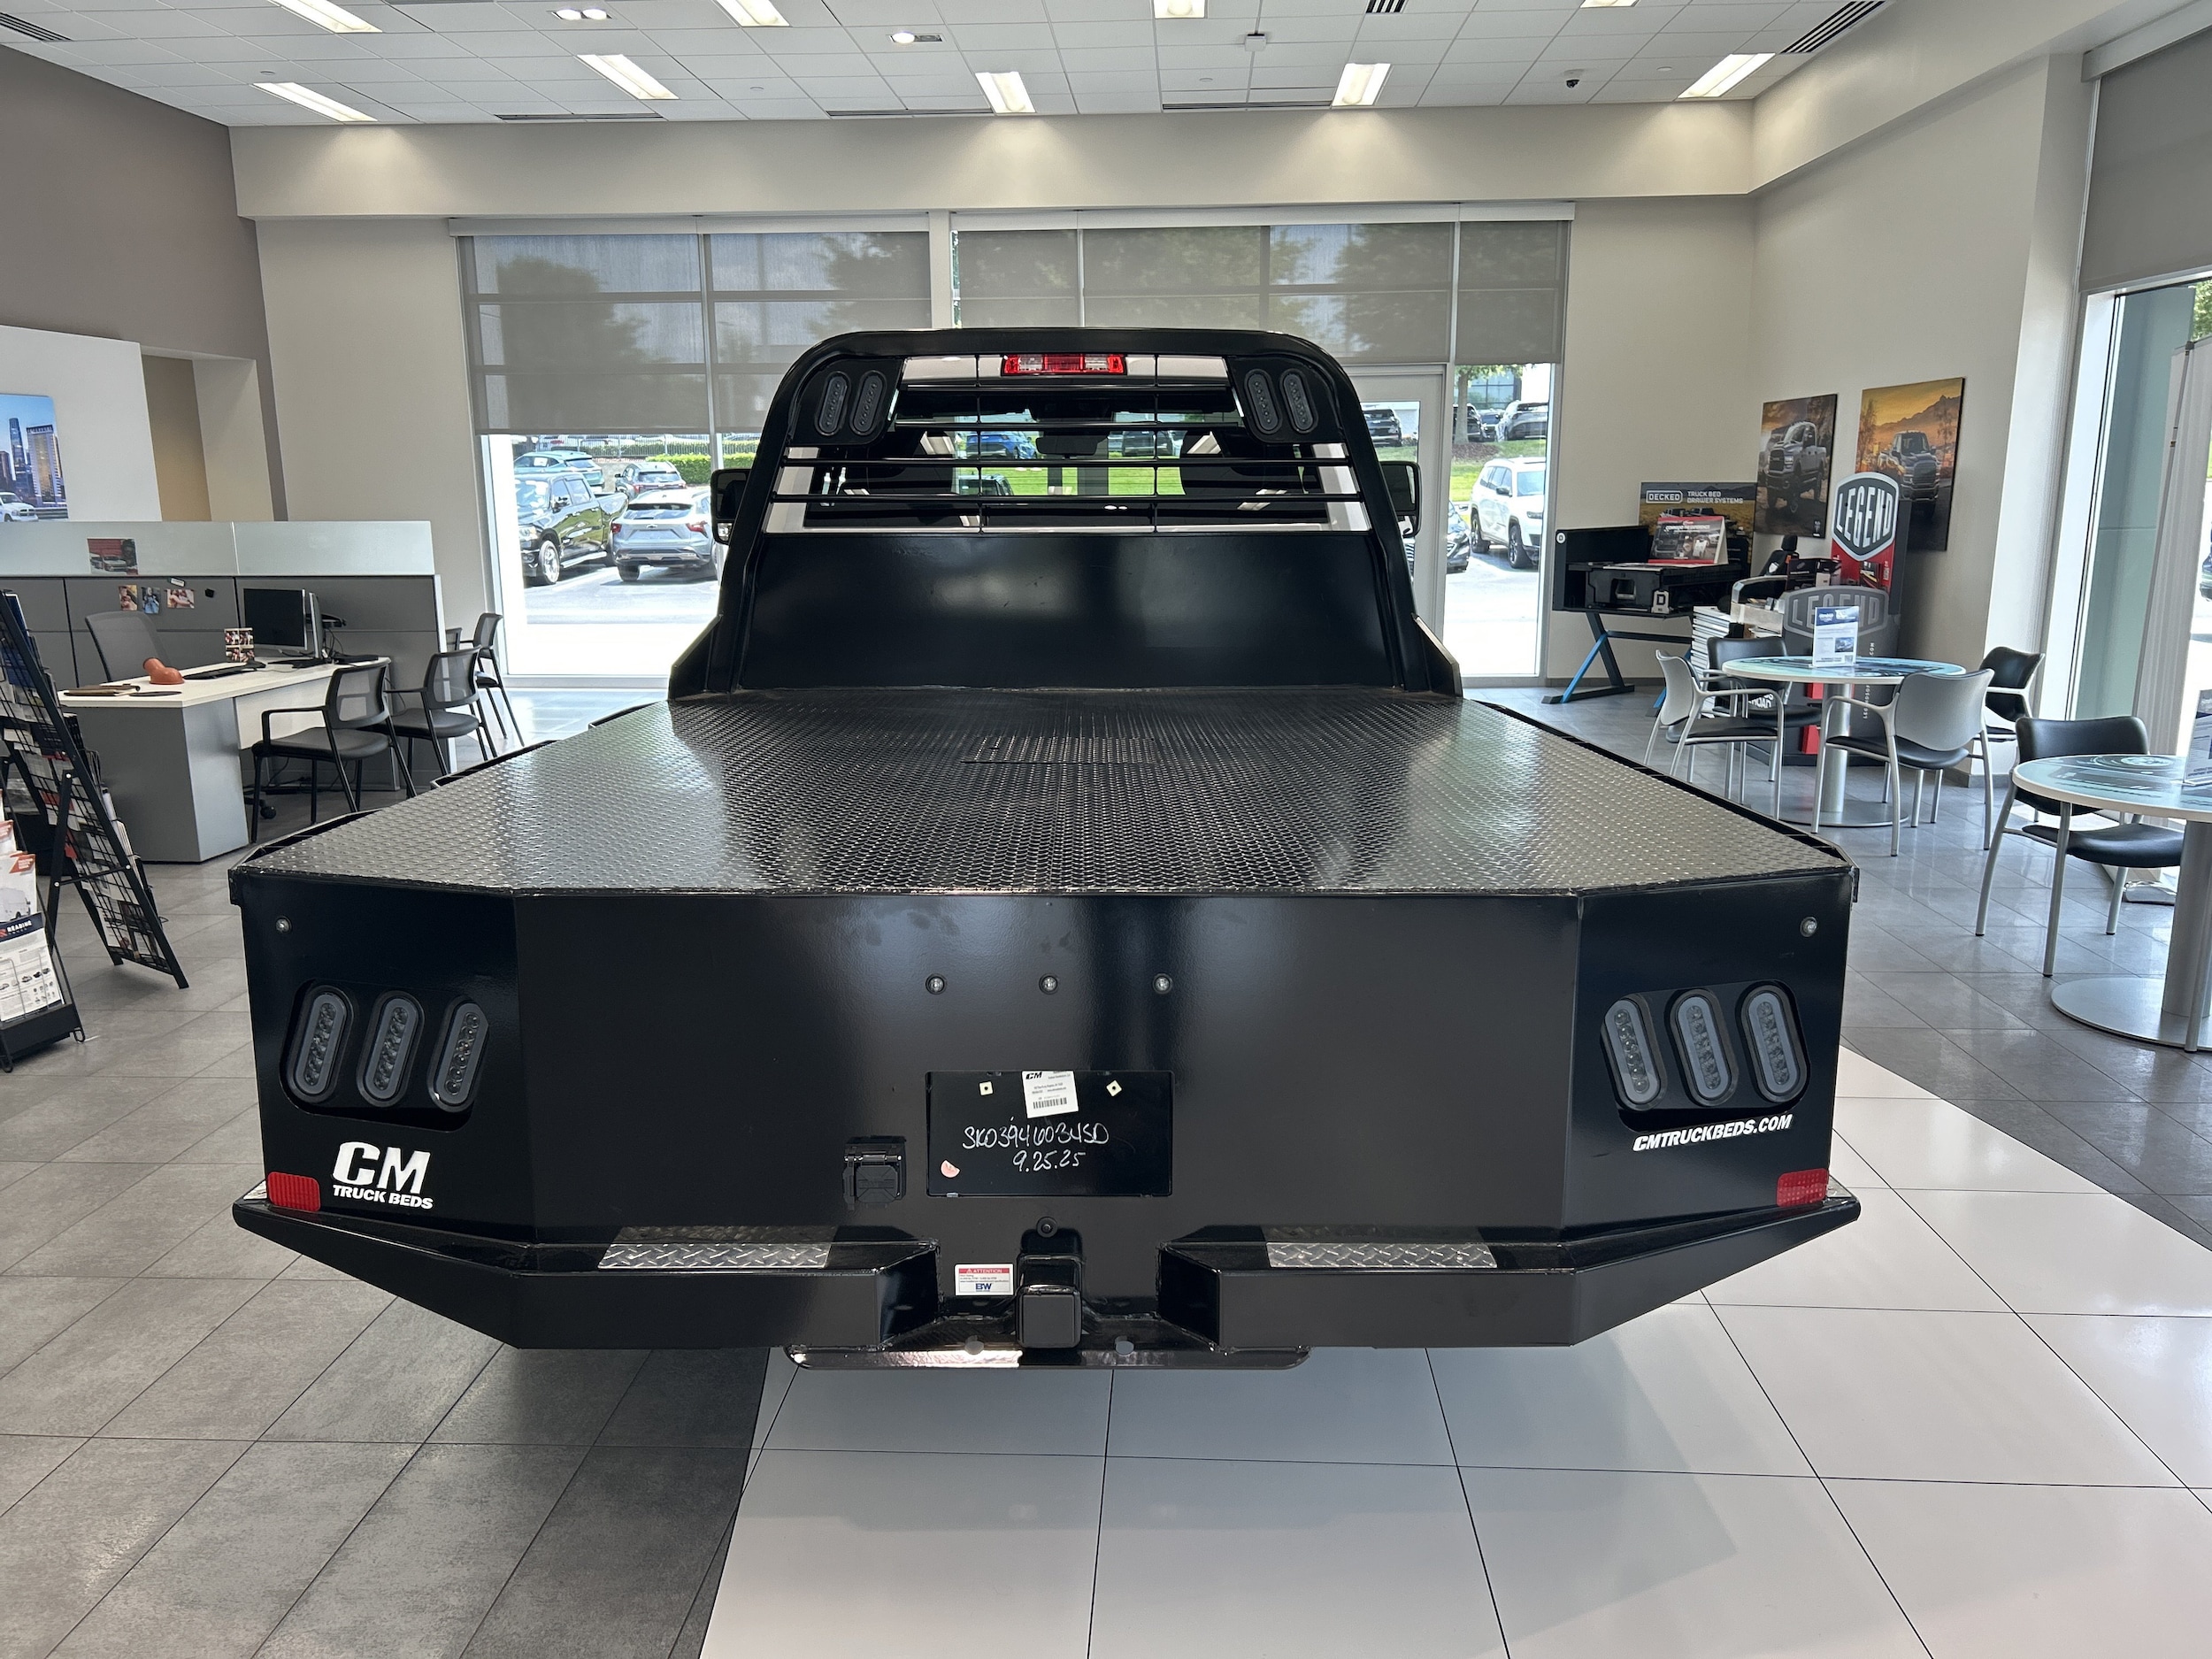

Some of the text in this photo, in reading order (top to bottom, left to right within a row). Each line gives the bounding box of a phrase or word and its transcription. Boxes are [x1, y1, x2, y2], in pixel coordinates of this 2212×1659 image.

[1836, 486, 1893, 549] LEGEND
[1656, 594, 1665, 605] D
[1632, 1113, 1793, 1152] CMTRUCKBEDS.COM
[333, 1141, 431, 1194] CM
[1012, 1149, 1087, 1172] 9.25.25
[333, 1184, 434, 1210] TRUCK BEDS
